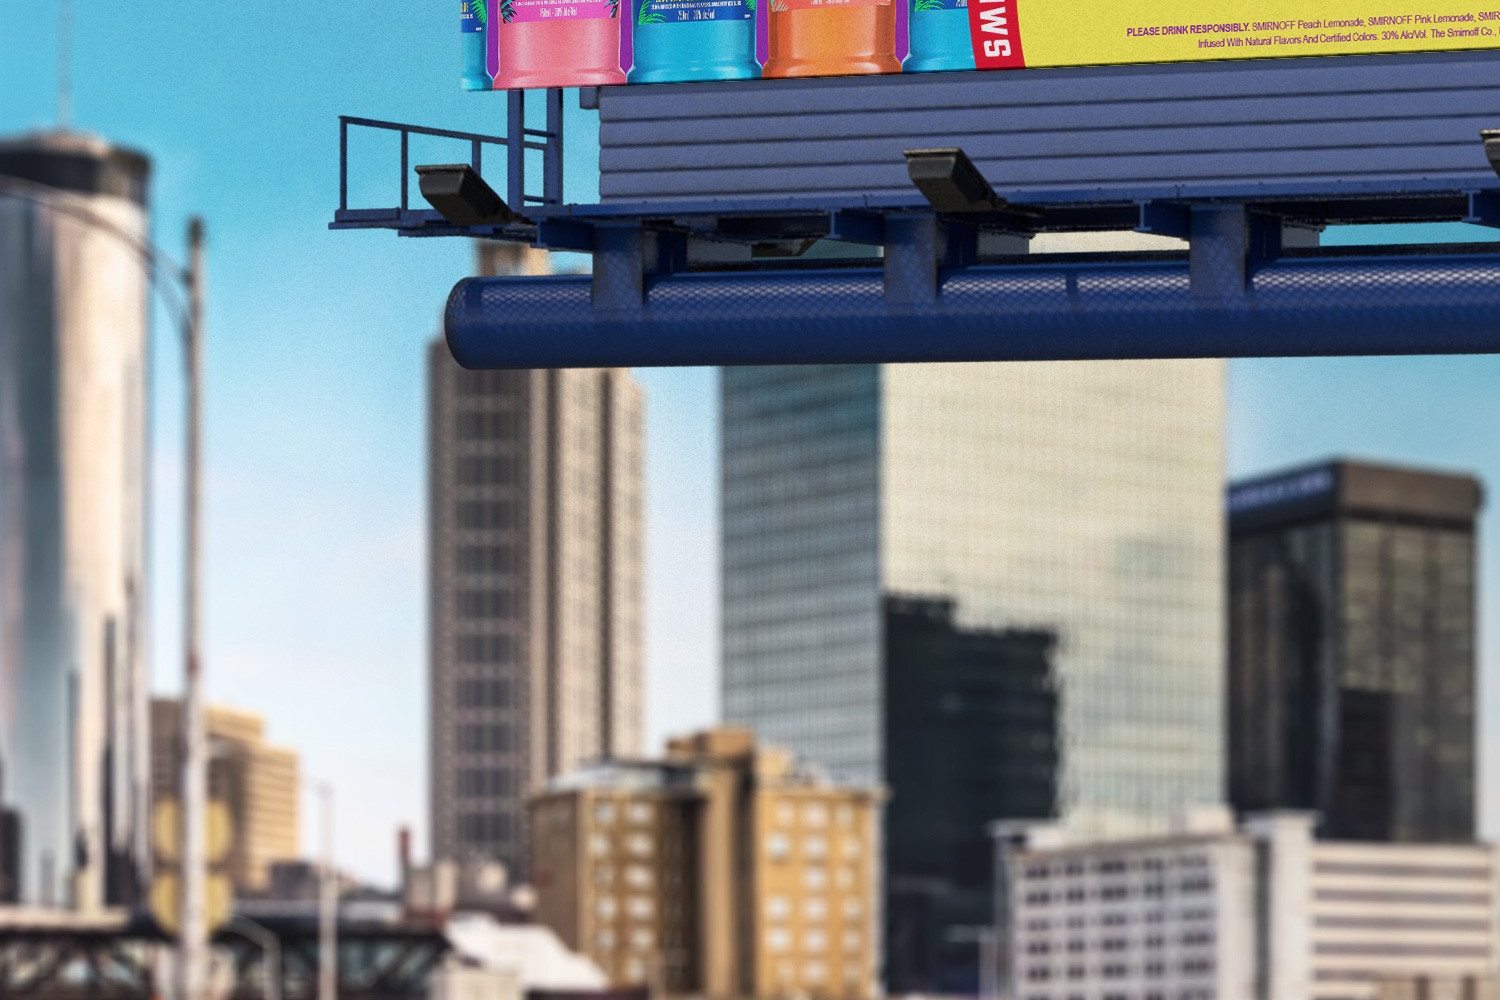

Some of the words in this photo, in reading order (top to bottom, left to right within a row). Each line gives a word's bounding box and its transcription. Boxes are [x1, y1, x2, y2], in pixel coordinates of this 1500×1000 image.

[1126, 27, 1160, 37] PLEASE
[1162, 25, 1188, 36] DRINK
[1190, 22, 1250, 34] RESPONSIBLY.
[1252, 20, 1296, 32] SMIRNOFF
[1298, 19, 1322, 30] Peach
[1324, 17, 1366, 29] Lemonade,
[1368, 15, 1412, 26] SMIRNOFF
[1414, 14, 1431, 24] Pink
[1433, 12, 1476, 23] Lemonade,
[1198, 38, 1225, 48] Infused
[1226, 37, 1244, 47] With
[1245, 36, 1272, 46] Natural
[1274, 35, 1302, 45] Flavors
[1302, 34, 1318, 44] And
[1319, 33, 1351, 43] Certified
[1353, 32, 1379, 42] Colors.
[1381, 31, 1399, 41] 30%
[1430, 28, 1445, 38] The
[1447, 27, 1480, 38] Smirnoff
[1481, 27, 1497, 37] Co.,
